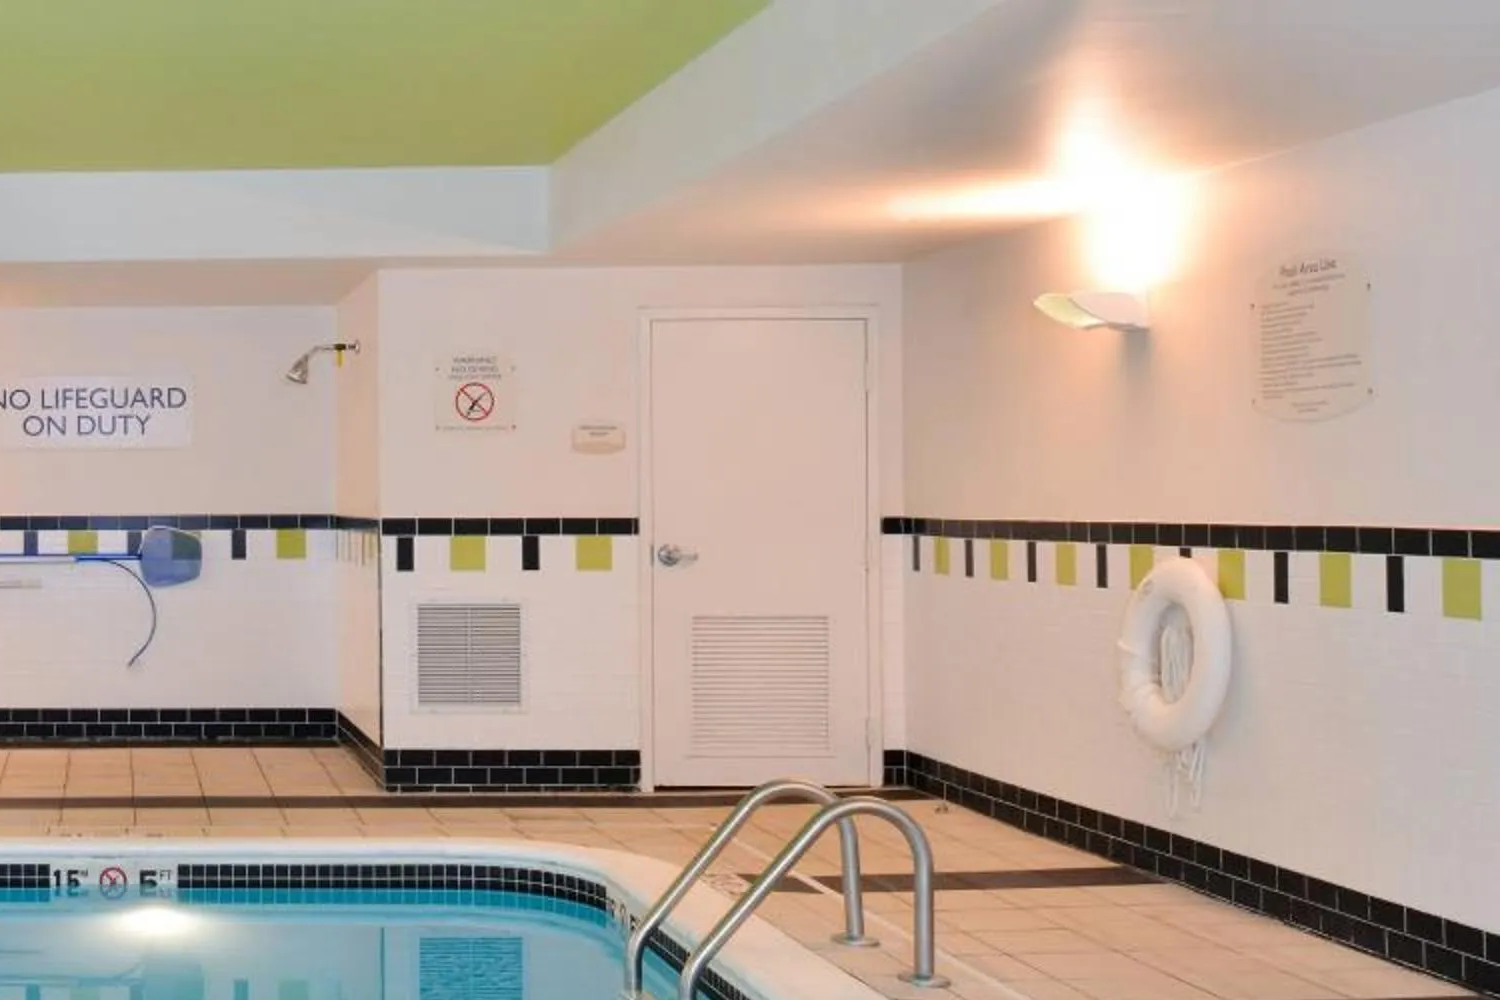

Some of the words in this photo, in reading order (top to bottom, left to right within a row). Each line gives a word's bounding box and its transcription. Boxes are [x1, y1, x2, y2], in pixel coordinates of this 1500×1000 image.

[41, 387, 187, 409] LIFEGUARD
[23, 415, 66, 437] ON
[77, 414, 151, 436] DUTY
